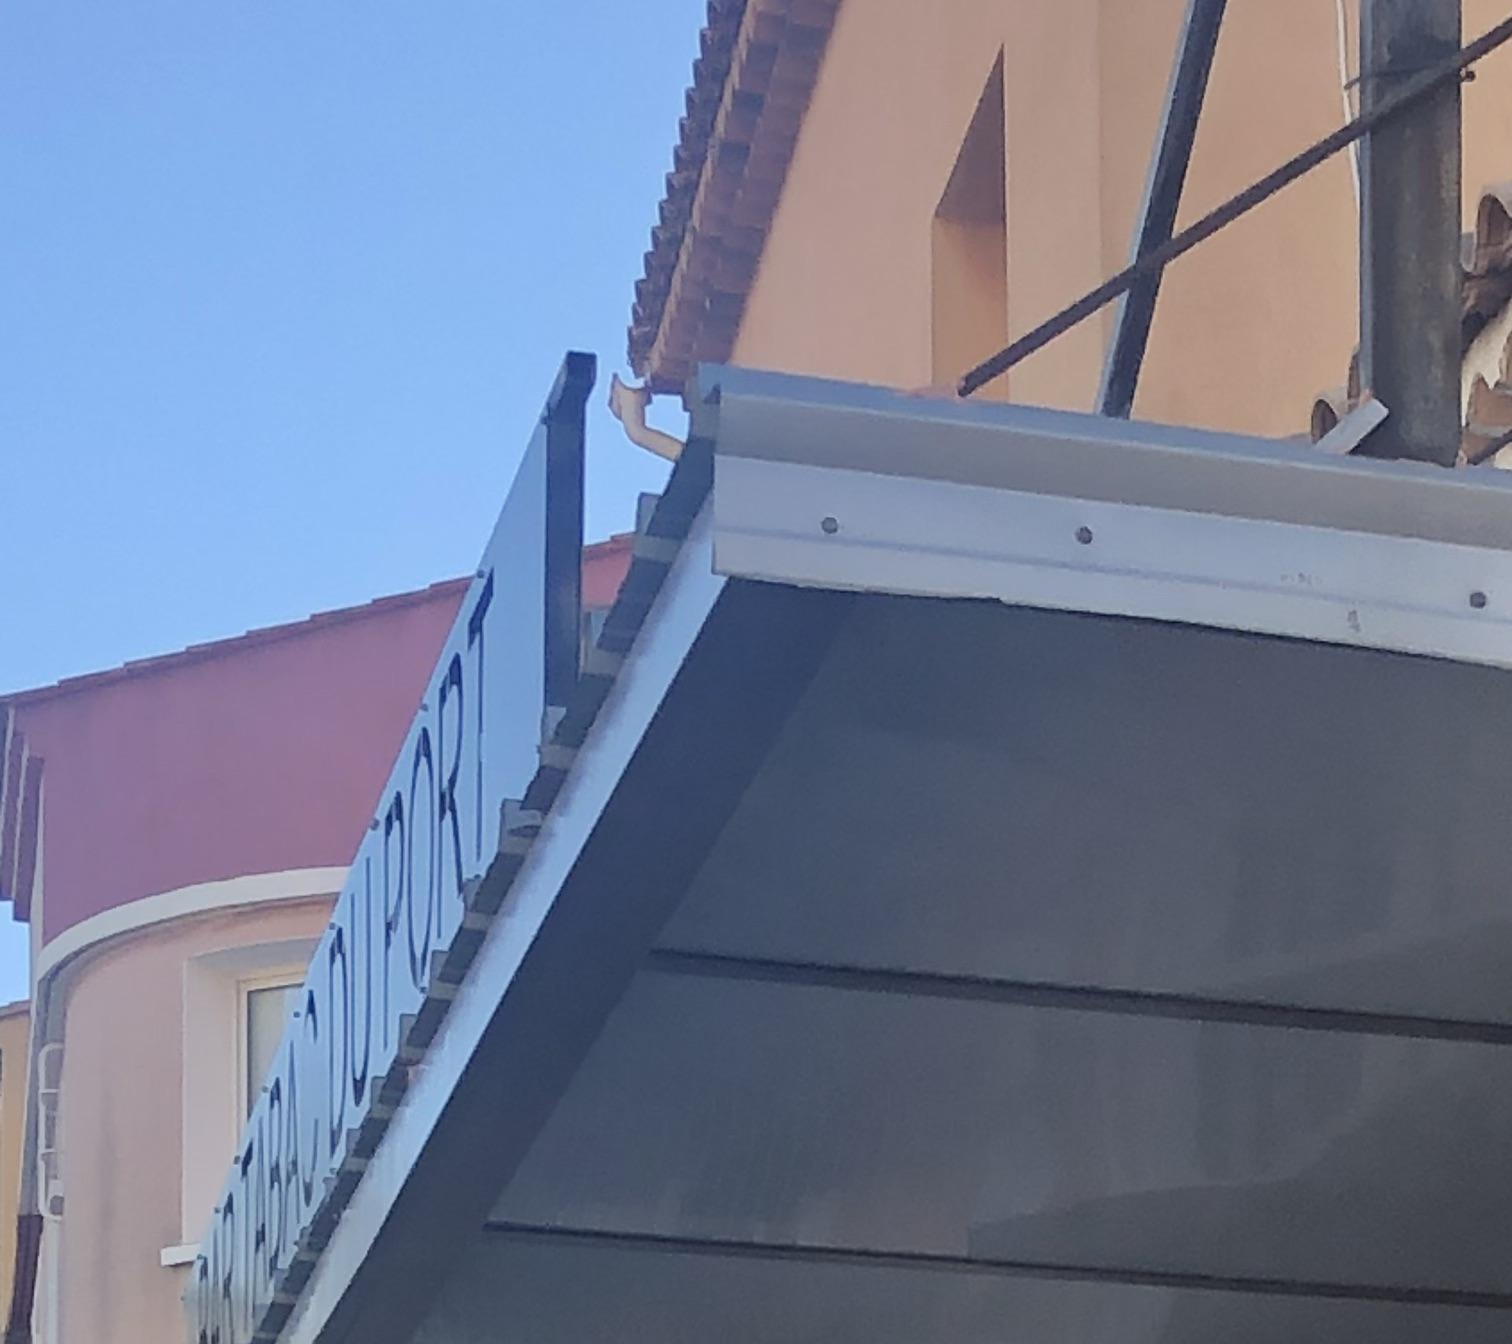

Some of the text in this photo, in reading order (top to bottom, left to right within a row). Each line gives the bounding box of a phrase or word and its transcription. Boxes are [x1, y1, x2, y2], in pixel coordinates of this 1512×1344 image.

[239, 988, 318, 1335] TABAC
[329, 857, 371, 1160] DU
[382, 566, 495, 1051] PORT
